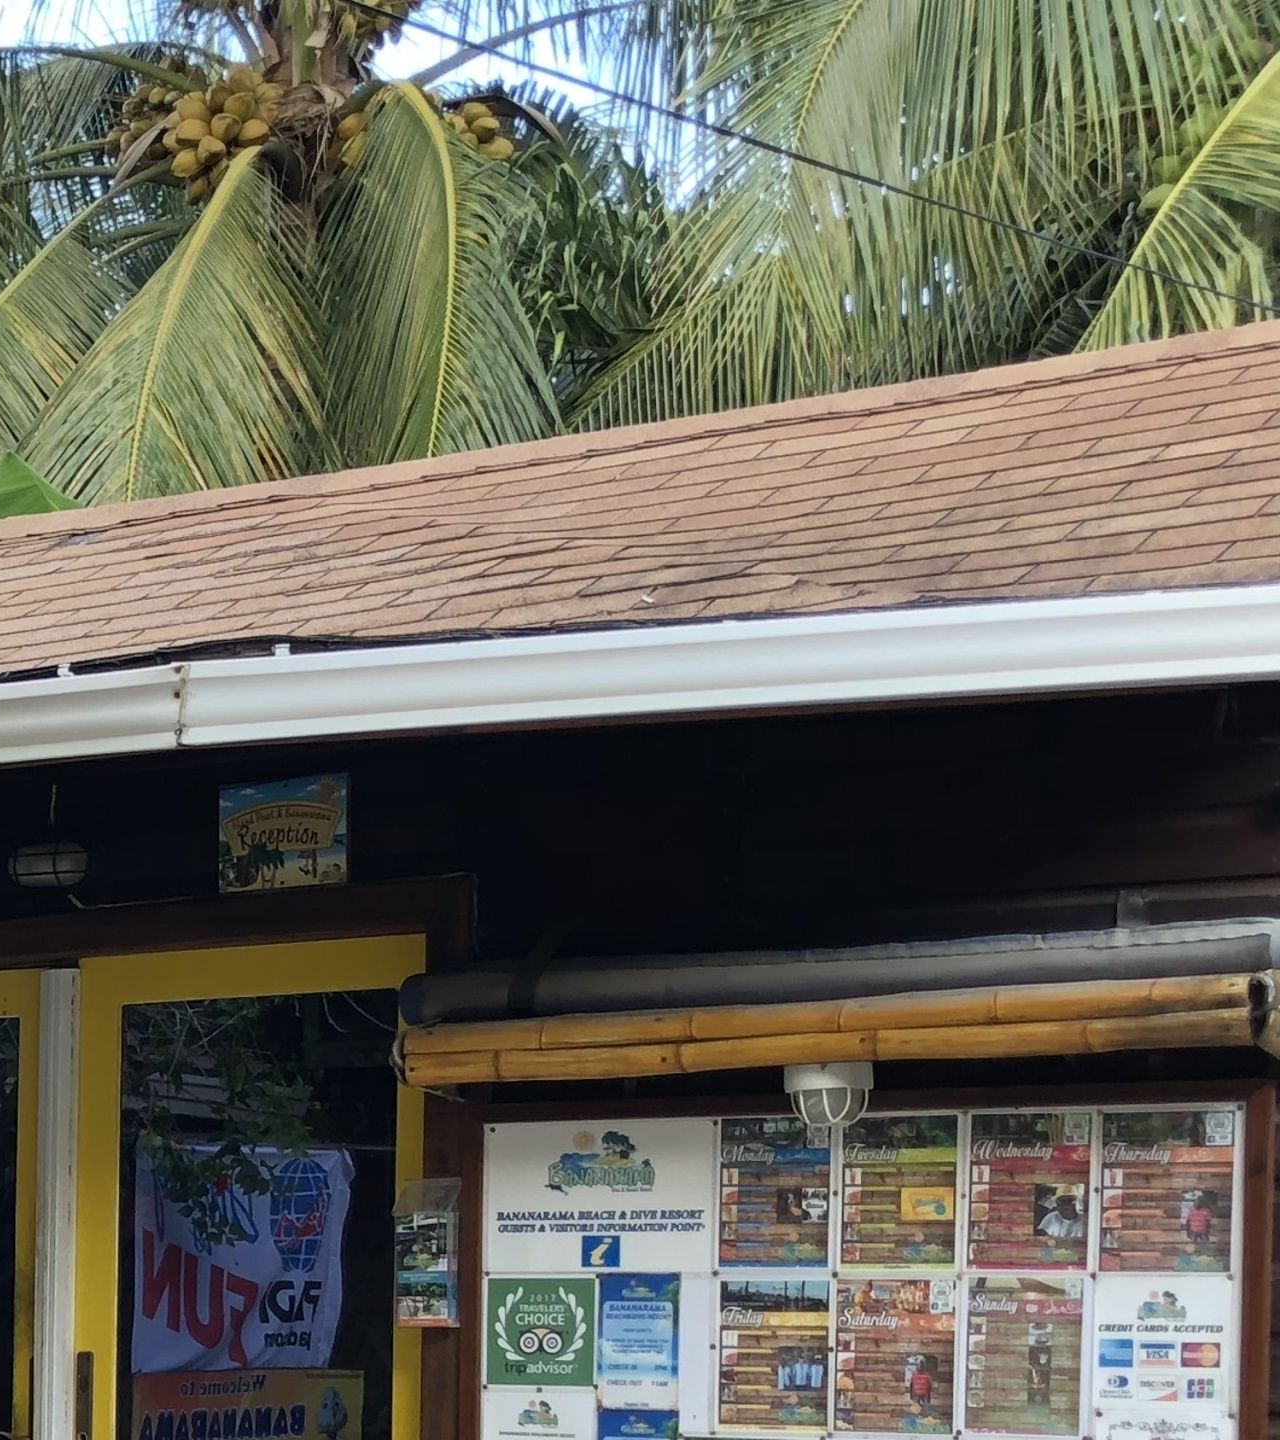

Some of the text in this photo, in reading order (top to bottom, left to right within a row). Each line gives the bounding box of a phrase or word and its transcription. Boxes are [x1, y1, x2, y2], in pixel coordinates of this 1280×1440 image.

[238, 822, 320, 852] Reception
[722, 1145, 776, 1165] Monday
[843, 1143, 899, 1163] Tuesday
[973, 1139, 1054, 1161] Wednesday
[1103, 1142, 1171, 1164] Thursday
[497, 1209, 704, 1221] BANANARAMA BEACH & DIVE RESORT
[498, 1223, 536, 1233] GUESTS
[538, 1223, 546, 1233] &
[550, 1223, 594, 1233] VISITORS
[597, 1223, 668, 1233] INFORMATION
[528, 1294, 556, 1303] 2017
[970, 1292, 1019, 1314] Sunday
[515, 1313, 565, 1326] CHOICE
[721, 1305, 765, 1329] Friday
[838, 1306, 899, 1330] Saturday
[1098, 1324, 1224, 1334] CREDIT CARDS ACCEPTED
[1146, 1350, 1170, 1359] VISA
[504, 1360, 573, 1376] tripadvisor
